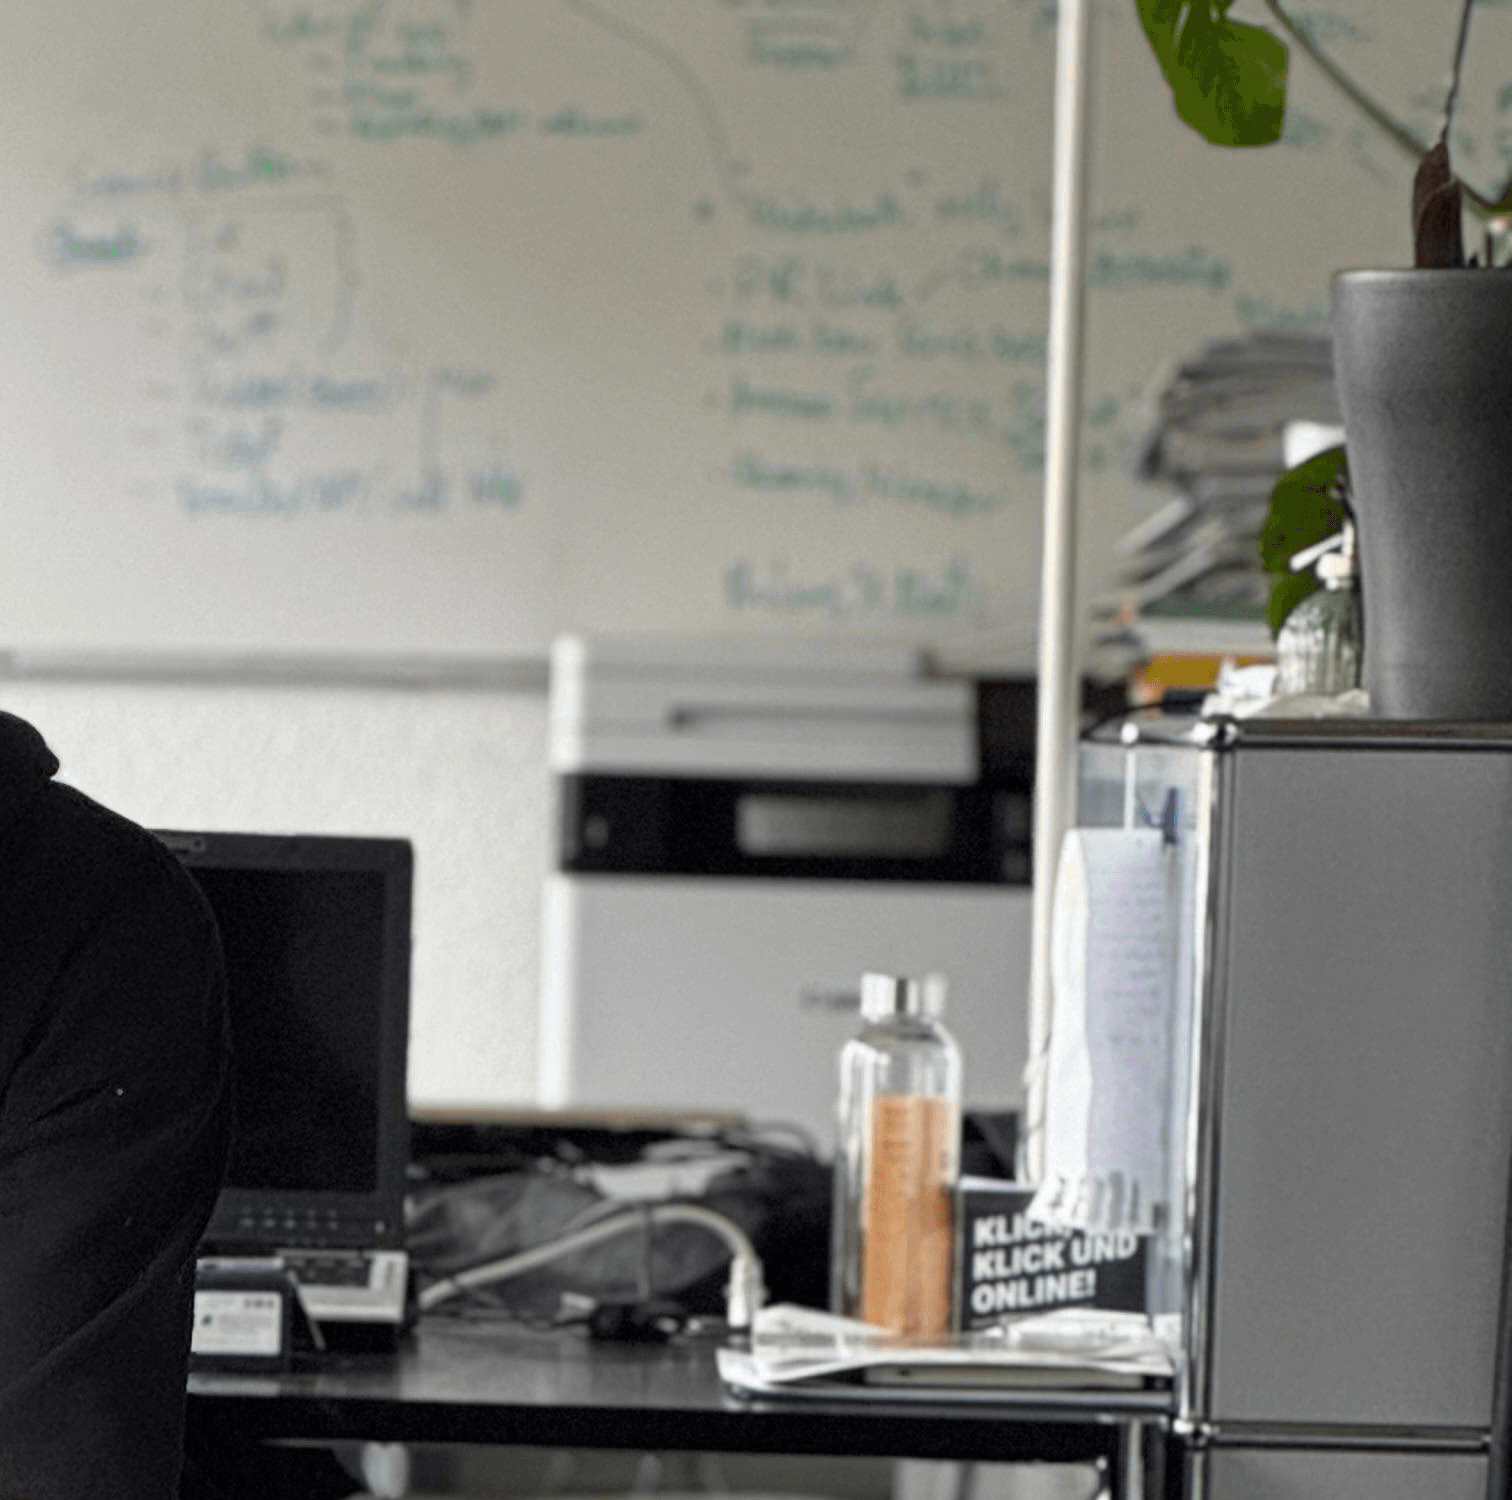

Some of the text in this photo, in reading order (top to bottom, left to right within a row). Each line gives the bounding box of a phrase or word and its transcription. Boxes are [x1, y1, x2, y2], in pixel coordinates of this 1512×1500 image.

[972, 1230, 1137, 1281] KLICK UND
[970, 1268, 1097, 1314] ONLINE!
